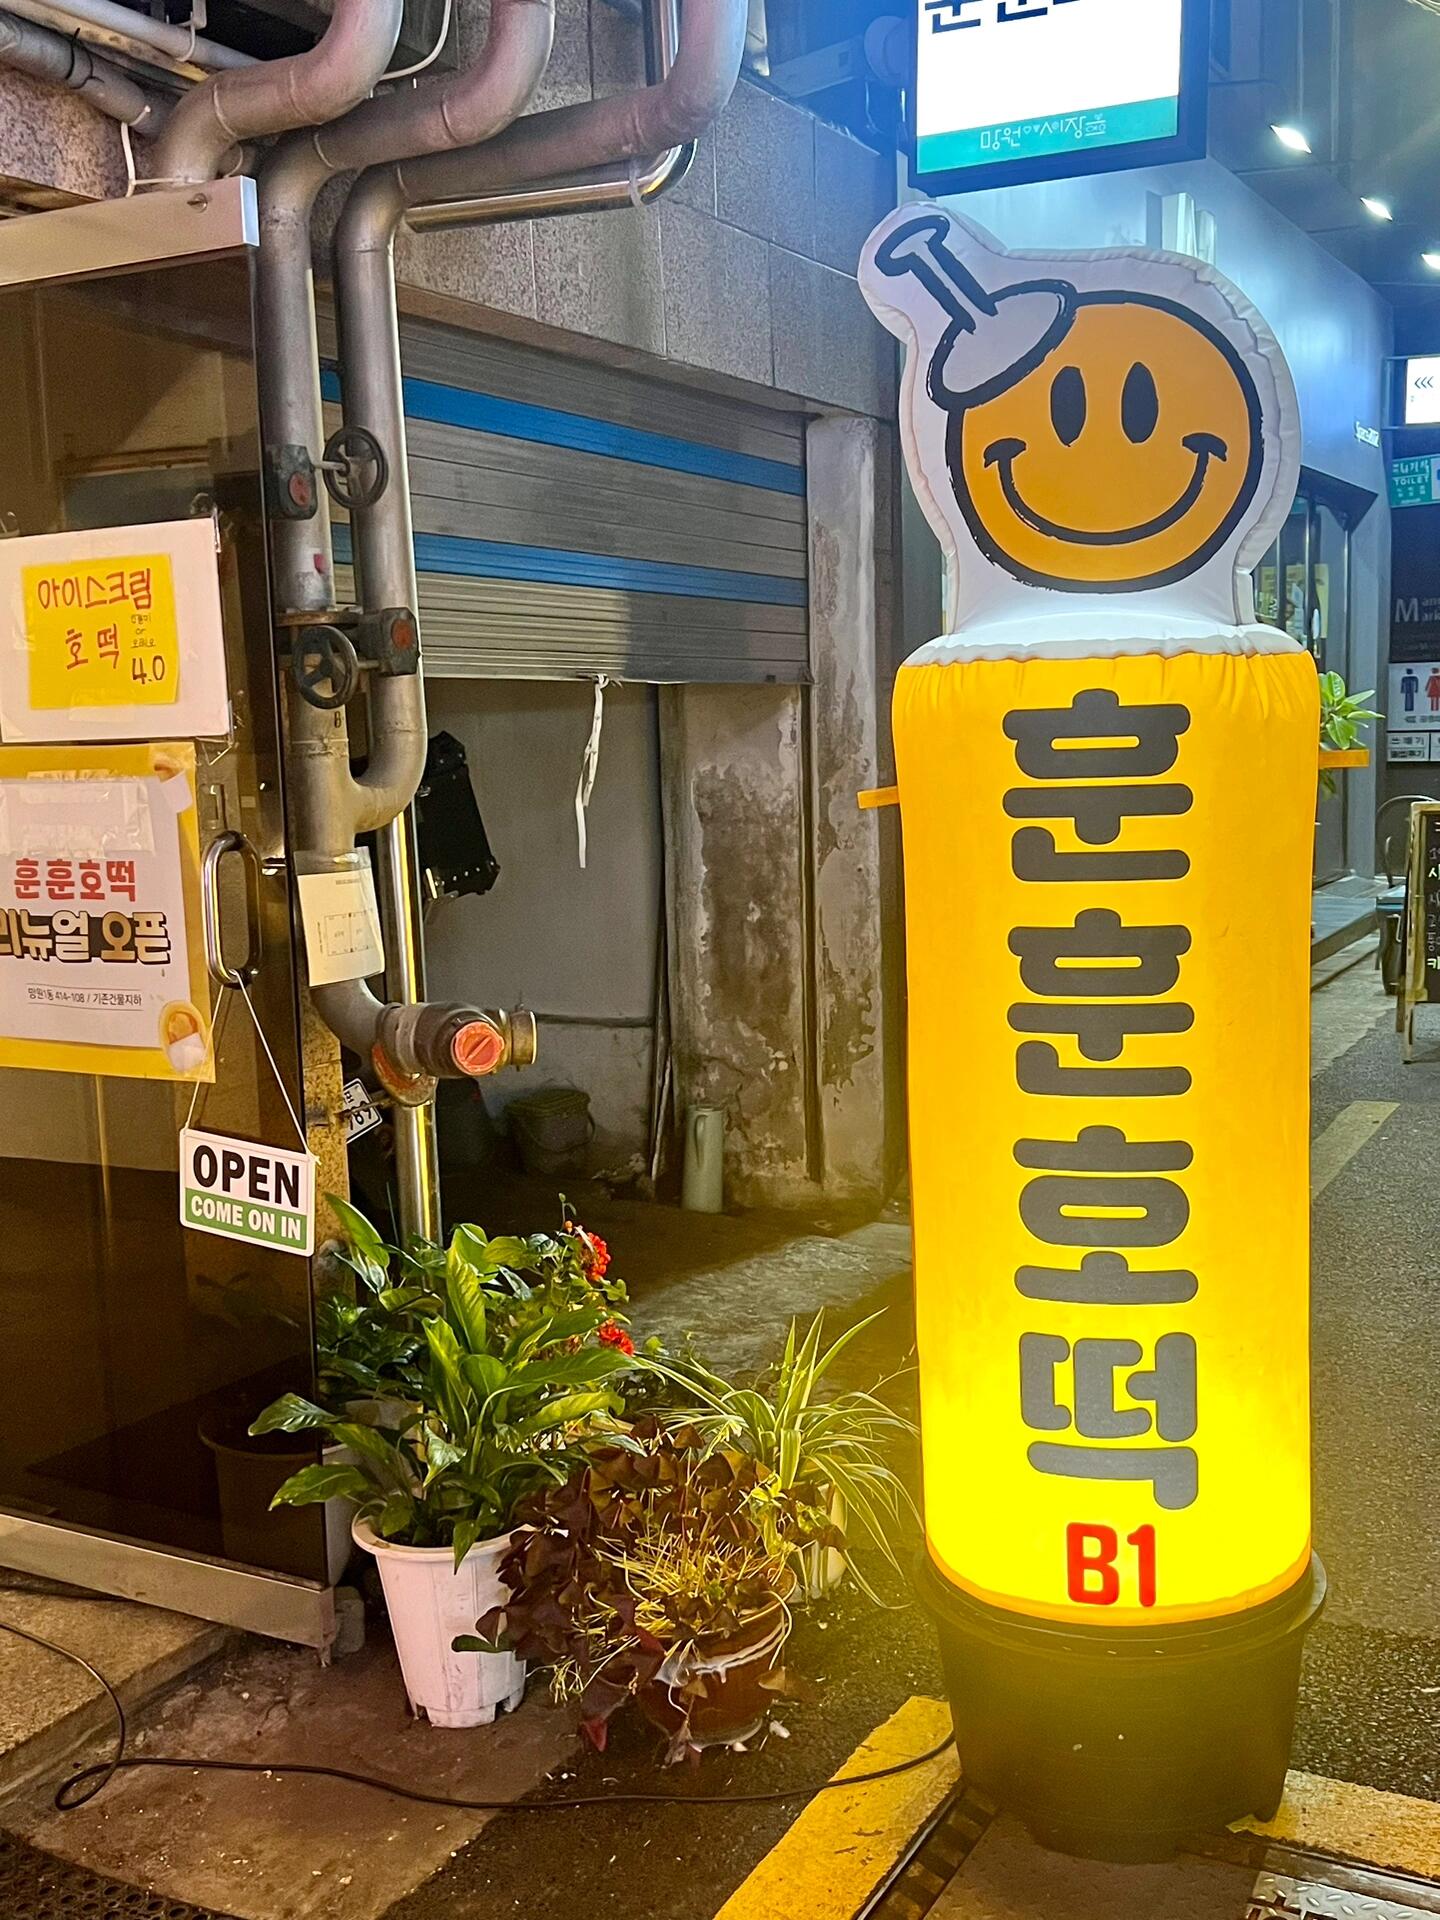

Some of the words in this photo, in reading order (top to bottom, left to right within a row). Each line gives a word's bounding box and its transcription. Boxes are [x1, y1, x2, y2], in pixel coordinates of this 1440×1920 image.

[1394, 475, 1429, 486] TOILET
[37, 567, 152, 610] 아이스크림
[131, 655, 165, 685] 4.0
[14, 858, 136, 902] 훈훈호떡
[101, 911, 172, 966] 오픈
[27, 987, 54, 1001] 망원1동
[55, 990, 86, 1003] 414-108
[93, 992, 142, 1007] 기존건물지하
[1002, 688, 1199, 1511] 훈훈호떡
[193, 1144, 300, 1209] OPEN
[191, 1195, 244, 1227] COME
[248, 1208, 275, 1235] ON
[281, 1215, 301, 1241] IN
[1066, 1522, 1156, 1608] B1
